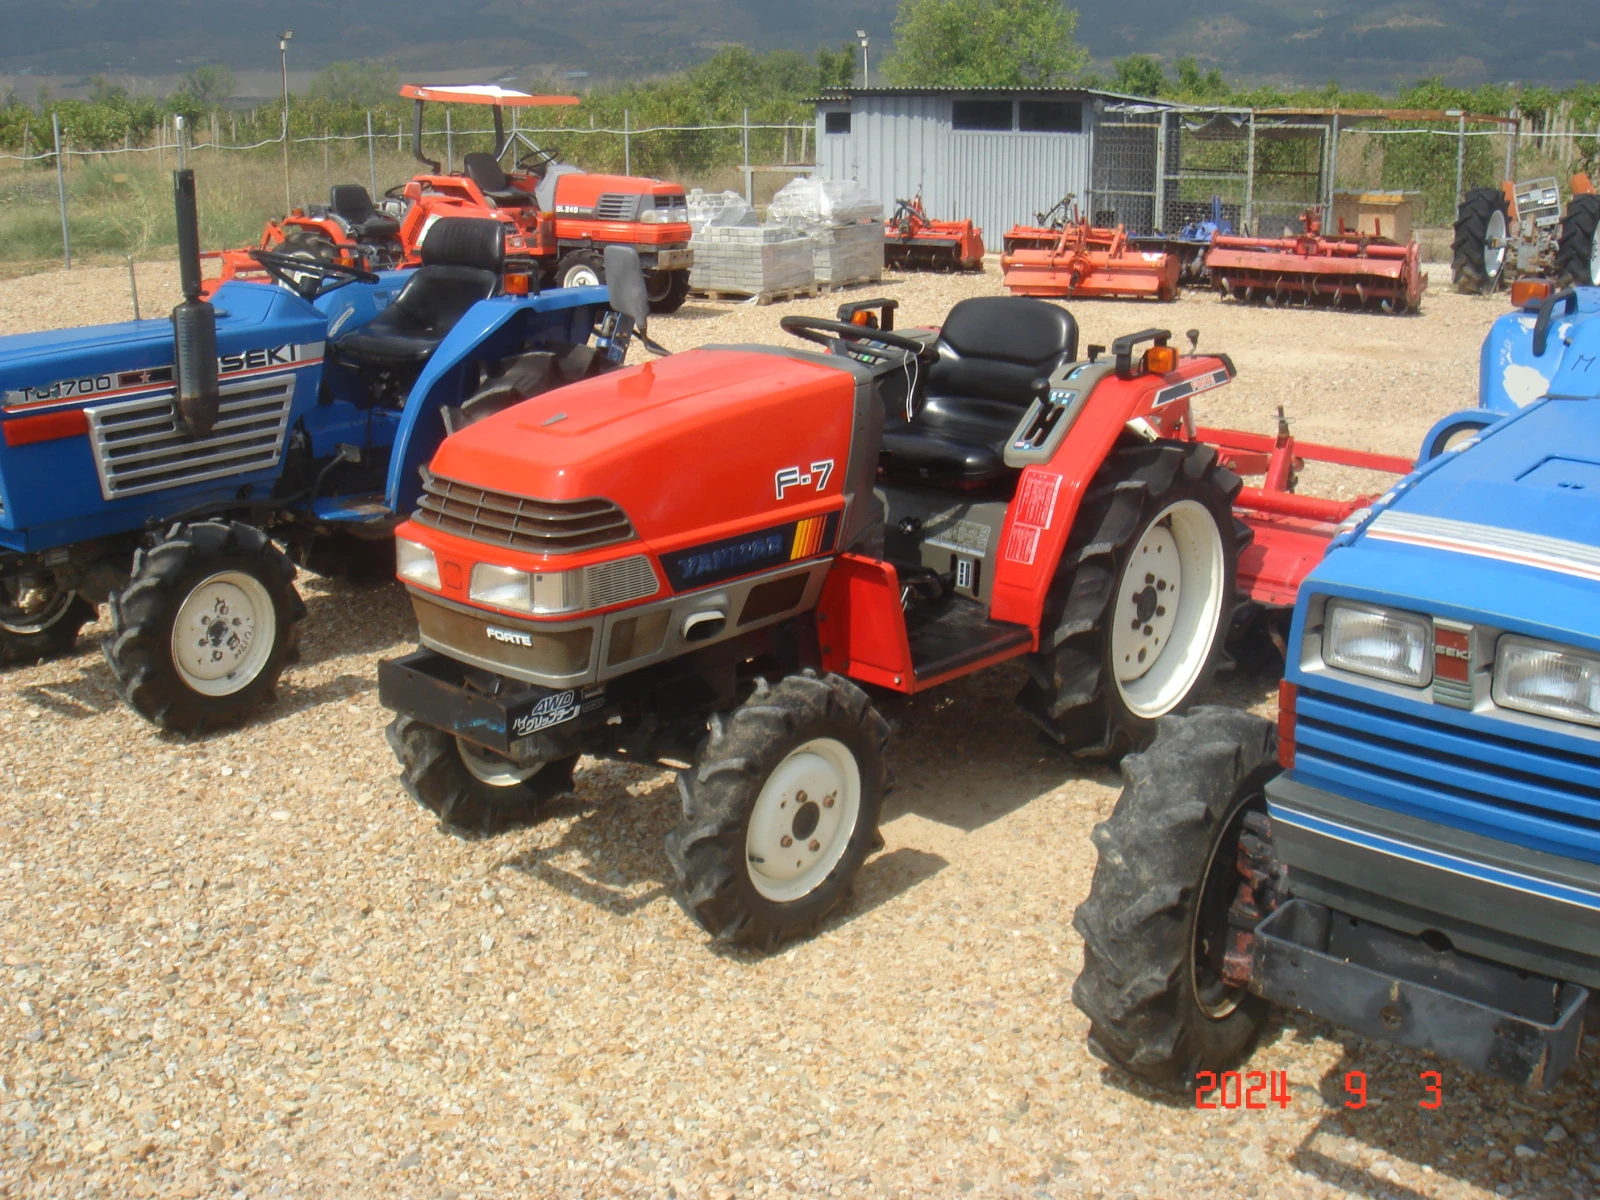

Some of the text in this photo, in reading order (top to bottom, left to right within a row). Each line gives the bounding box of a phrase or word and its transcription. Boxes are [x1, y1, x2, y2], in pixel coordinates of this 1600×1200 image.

[220, 342, 297, 374] SEKI
[775, 459, 834, 500] F-7
[486, 626, 533, 647] FORTE
[532, 690, 575, 717] 4WD
